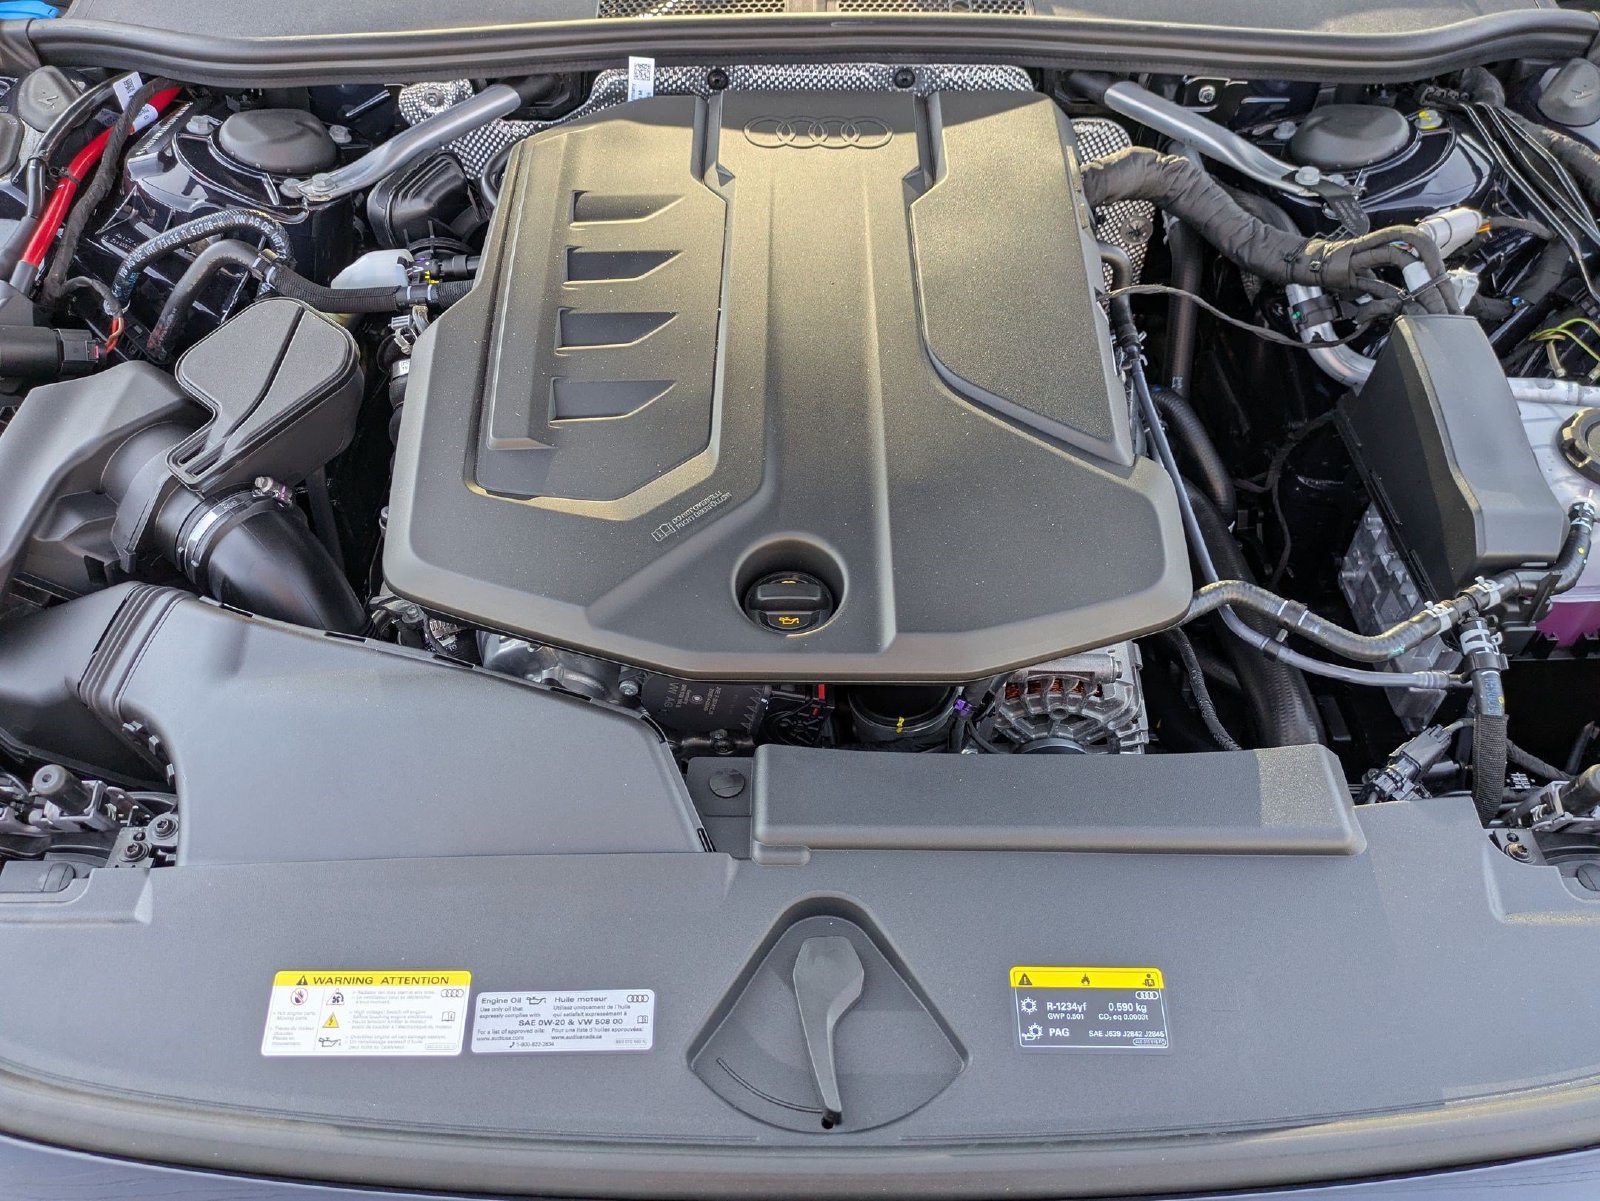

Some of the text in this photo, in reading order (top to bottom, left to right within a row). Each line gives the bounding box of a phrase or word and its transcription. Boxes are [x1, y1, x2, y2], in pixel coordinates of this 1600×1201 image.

[232, 213, 246, 225] VW
[247, 214, 261, 227] AG
[260, 220, 274, 235] DE
[313, 976, 451, 985] WARNING ATTENTION
[481, 997, 509, 1006] Engine
[554, 996, 575, 1004] Huile
[1046, 1001, 1088, 1013] R-1234yf
[1108, 1002, 1148, 1014] 0.590 kg
[1047, 1012, 1066, 1020] GWP
[518, 1017, 625, 1027] SAE 0W-20 & VW 508 00
[1049, 1027, 1070, 1037] PAG
[1104, 1030, 1121, 1038] J639
